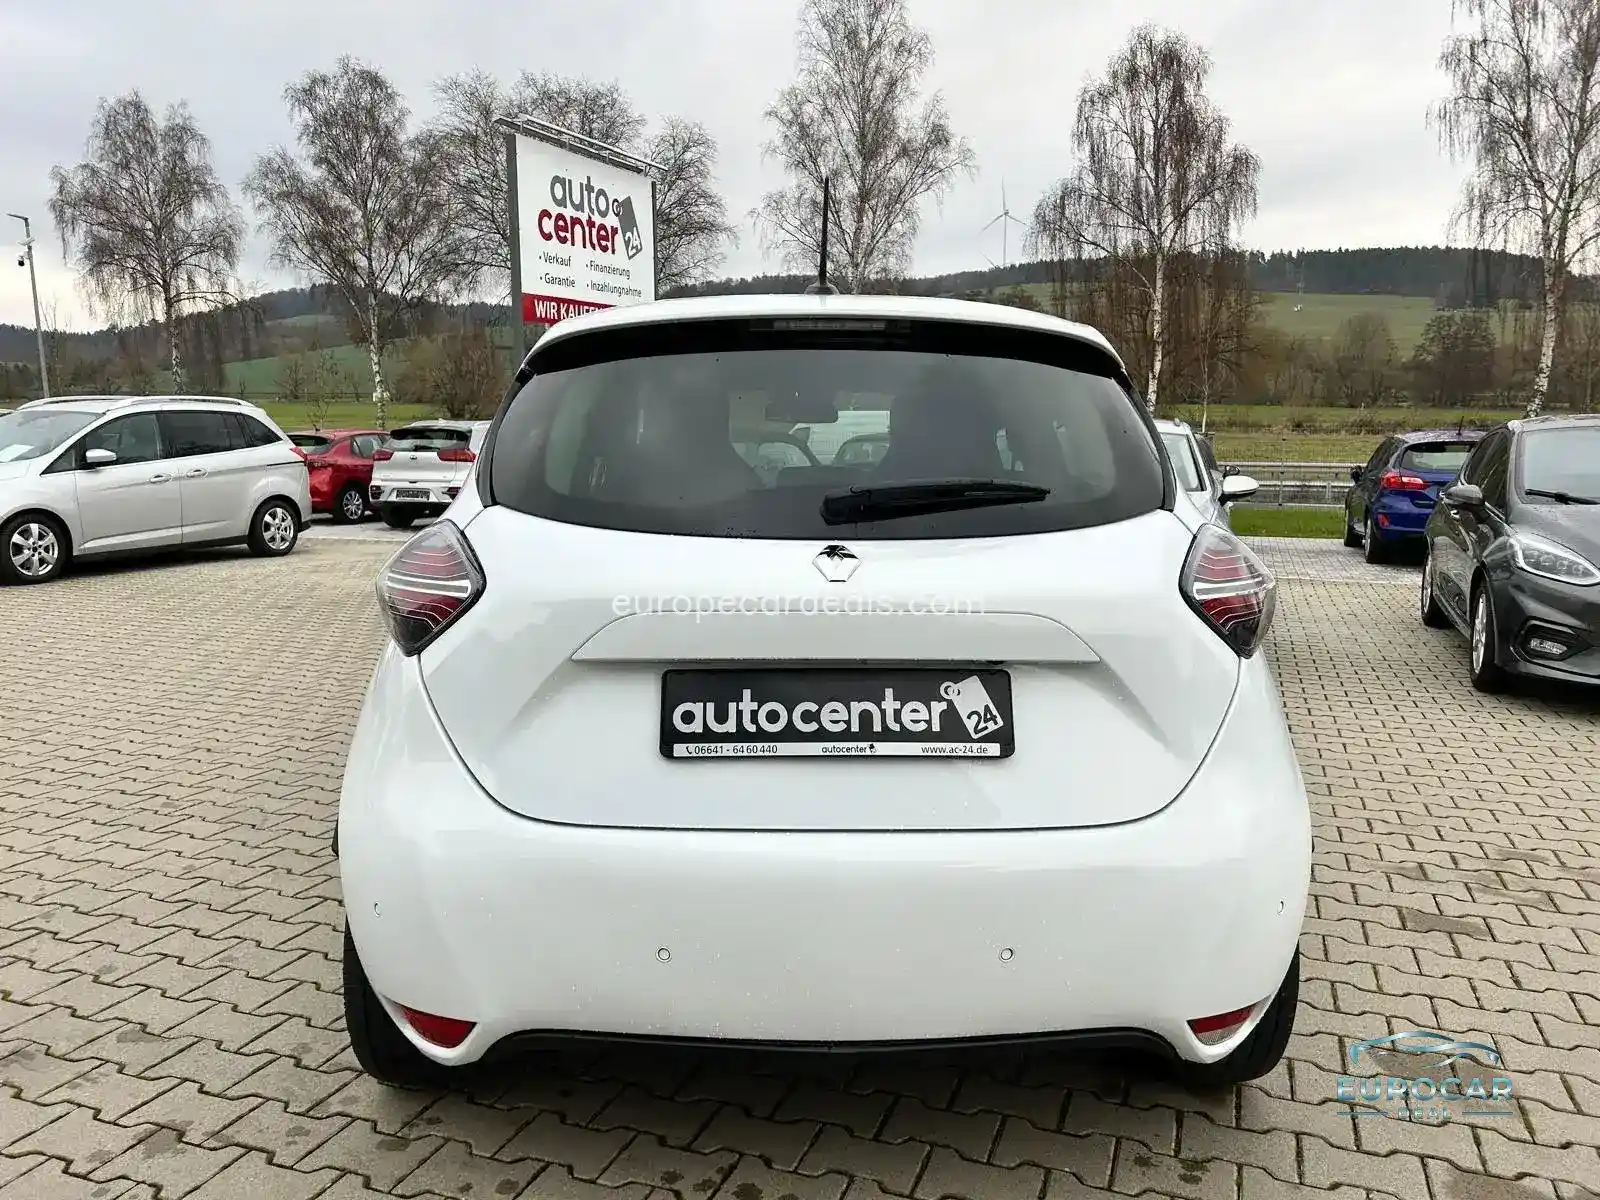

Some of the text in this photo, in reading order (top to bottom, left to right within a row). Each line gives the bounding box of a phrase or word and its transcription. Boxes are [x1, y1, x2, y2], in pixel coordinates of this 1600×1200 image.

[550, 175, 610, 218] auto
[538, 209, 619, 254] center
[625, 227, 642, 257] 24
[543, 251, 572, 267] Verkauf
[589, 260, 631, 280] Finanzierung
[544, 273, 576, 288] Garantie
[590, 280, 642, 298] Inzahlungnahme
[534, 299, 558, 320] WIR
[966, 704, 1000, 735] 24
[694, 745, 723, 755] 06641
[821, 744, 867, 754] autocenter
[921, 744, 989, 755] www.ac-24.de
